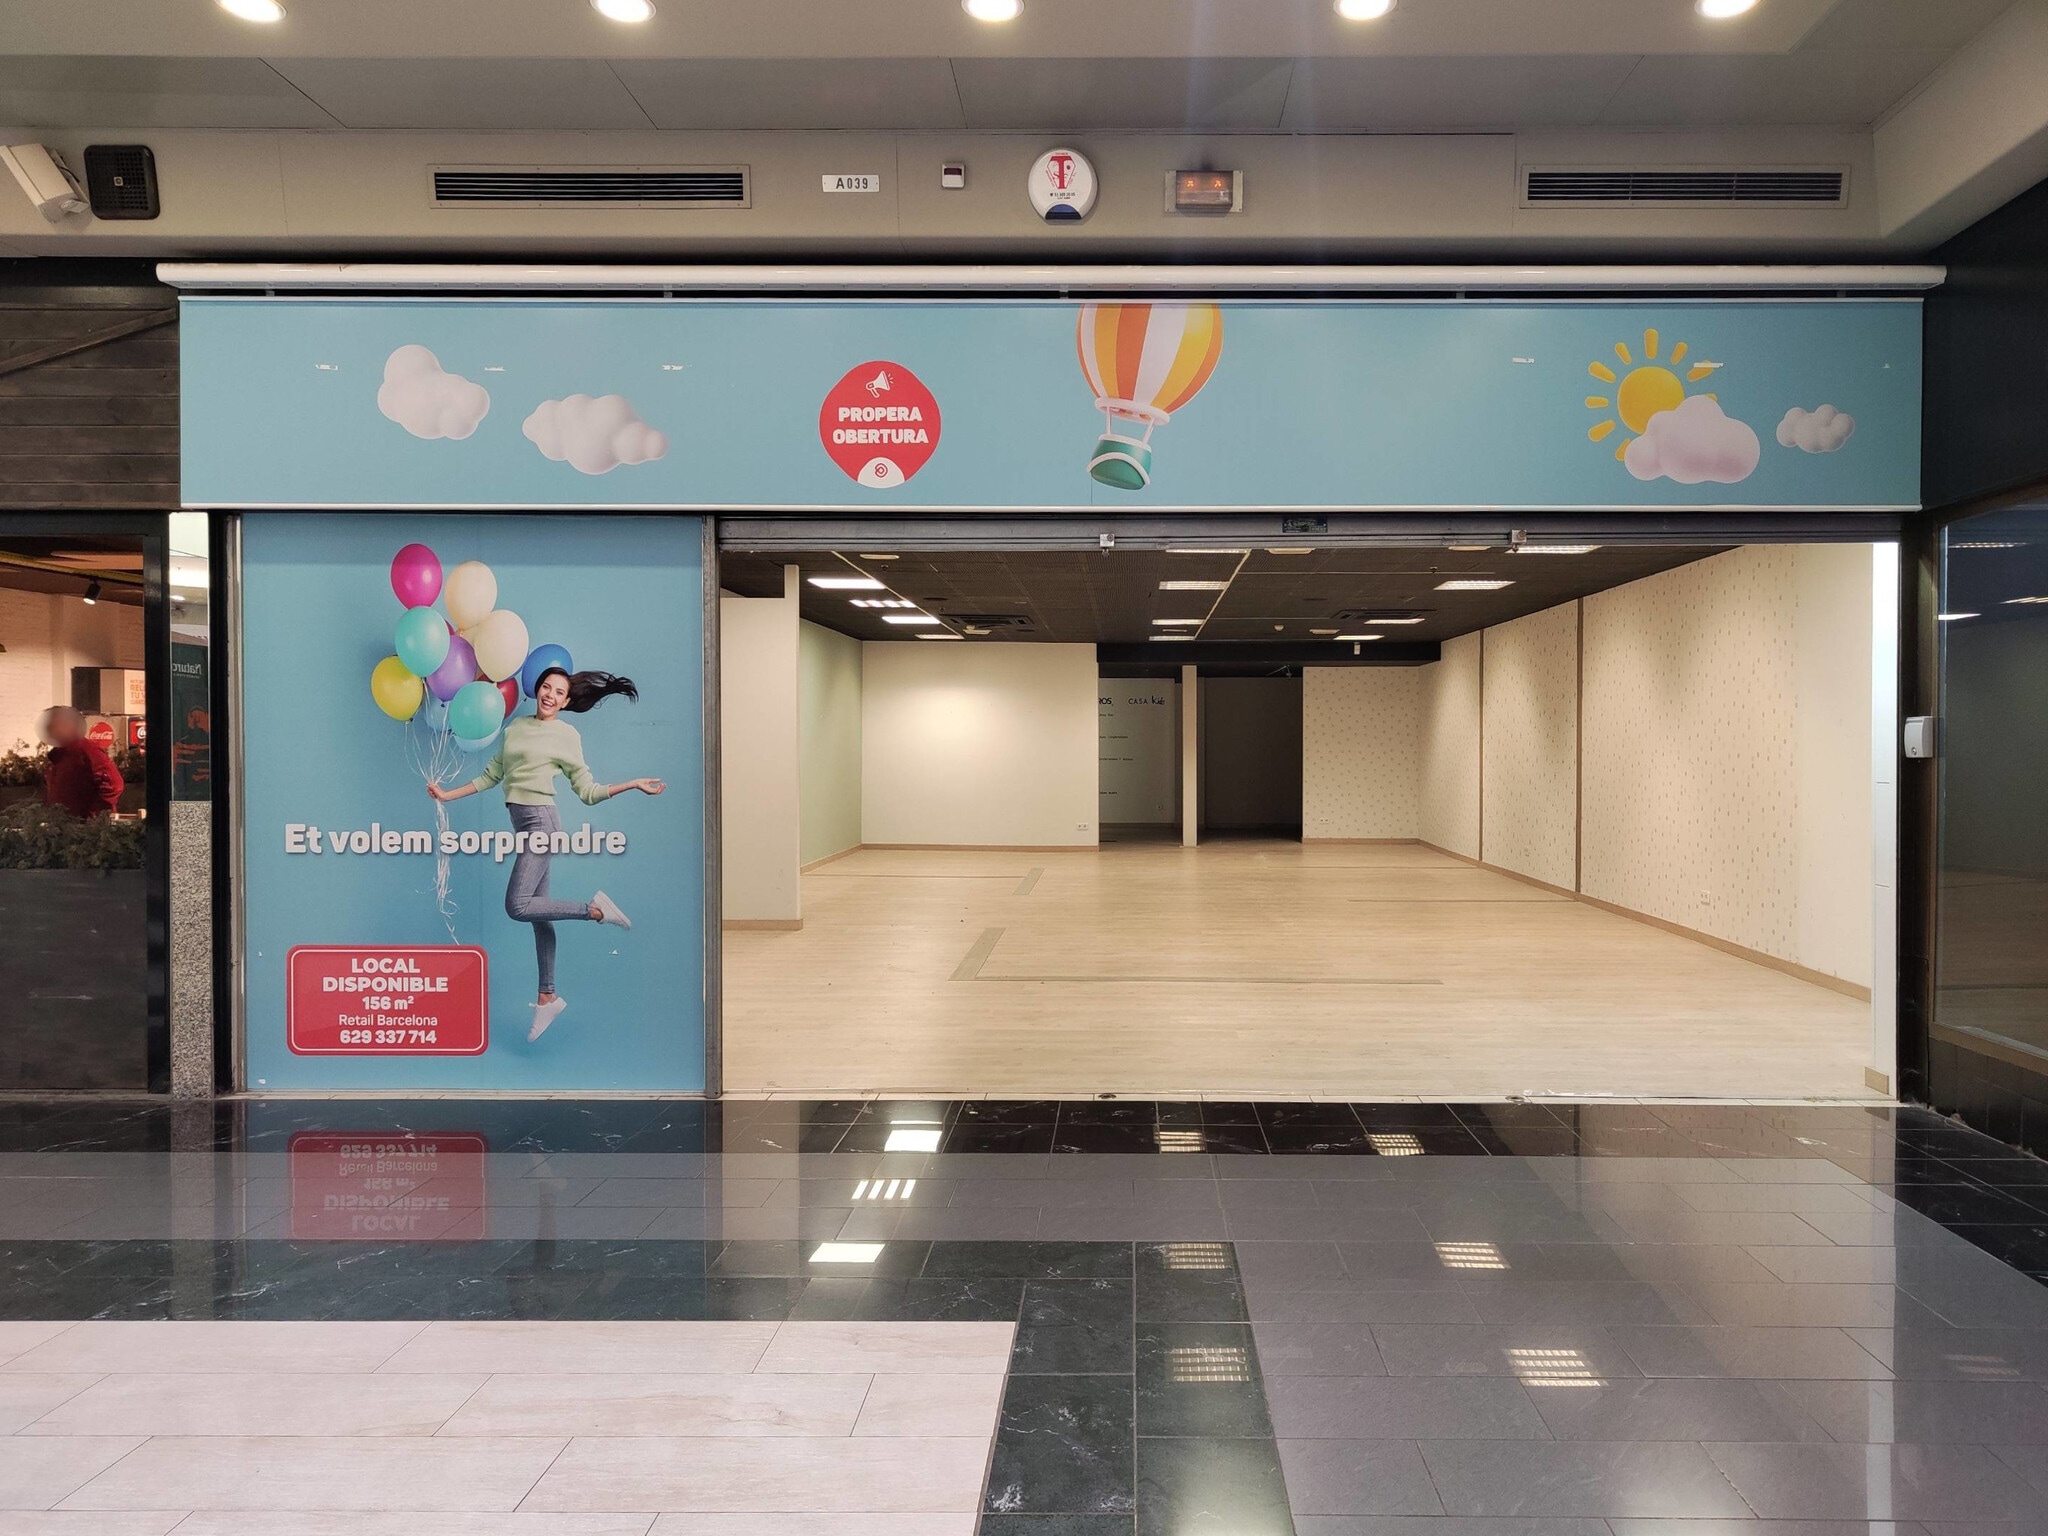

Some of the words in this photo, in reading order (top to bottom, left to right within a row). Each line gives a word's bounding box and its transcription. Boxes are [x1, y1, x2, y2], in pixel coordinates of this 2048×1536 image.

[836, 177, 868, 190] A039
[838, 406, 922, 422] PROPERA
[832, 428, 929, 444] OBERTURA
[1128, 697, 1148, 705] CASA
[284, 823, 322, 854] Et
[328, 822, 433, 855] volem
[440, 823, 627, 863] sorprendre
[351, 957, 420, 974] LOCAL
[322, 976, 449, 993] DISPONIBLE
[361, 996, 392, 1010] 156
[338, 1014, 374, 1026] Retail
[377, 1014, 438, 1026] Barcelona
[339, 1030, 372, 1044] 629
[375, 1030, 406, 1044] 337
[408, 1030, 437, 1044] 714
